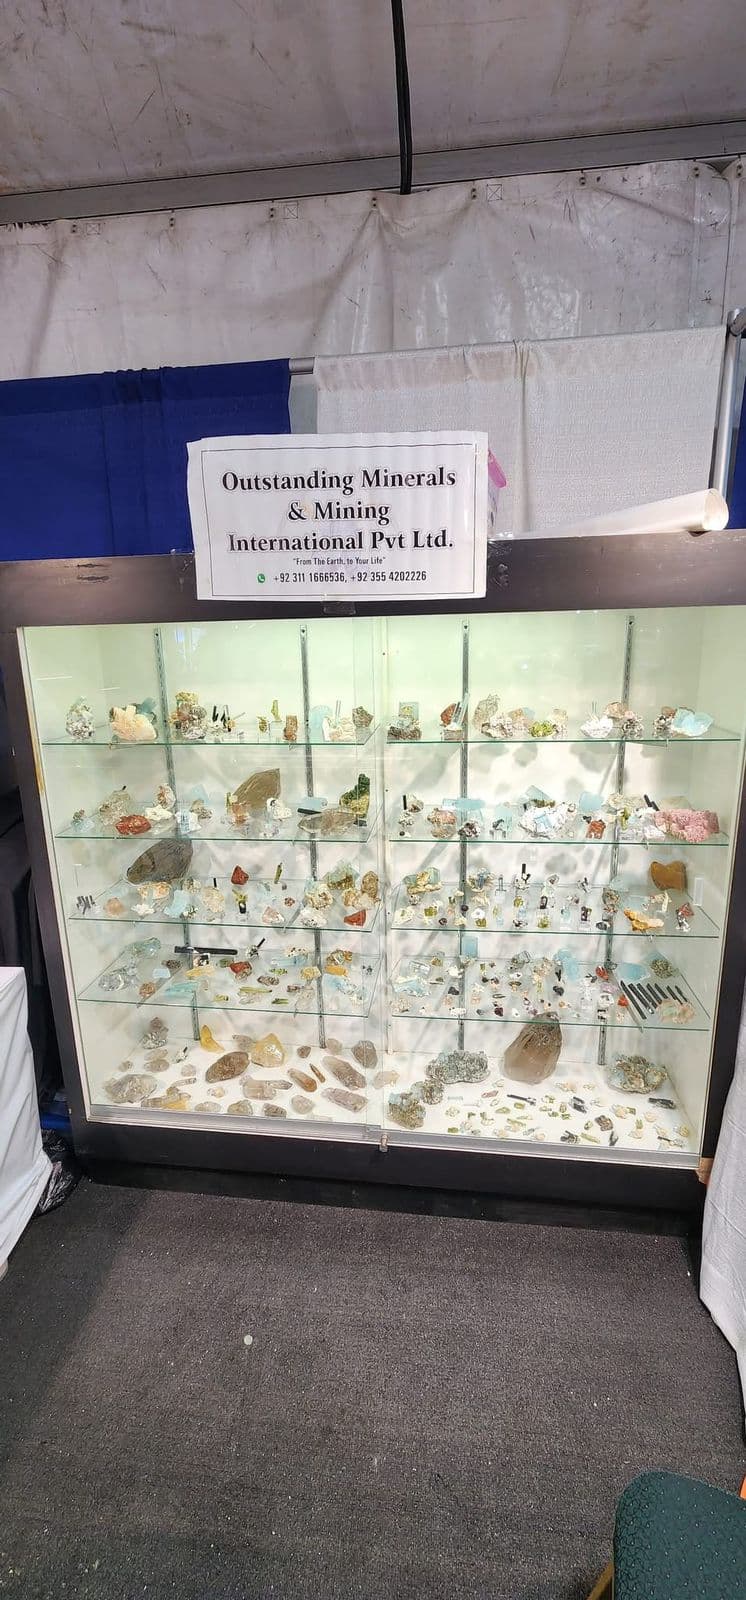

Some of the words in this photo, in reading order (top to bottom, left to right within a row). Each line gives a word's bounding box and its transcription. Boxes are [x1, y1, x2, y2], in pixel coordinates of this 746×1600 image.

[222, 469, 354, 494] Outstanding
[361, 466, 456, 489] Minerals
[288, 502, 307, 521] &
[314, 501, 390, 526] Mining
[228, 532, 363, 552] International
[372, 531, 405, 549] Pvt
[413, 529, 453, 549] Ltd.
[313, 557, 326, 566] The
[346, 557, 354, 566] to
[355, 557, 370, 566] Your
[273, 572, 290, 583] +92
[292, 572, 306, 583] 311
[308, 571, 348, 585] 1666536,
[350, 571, 369, 582] +92
[370, 571, 387, 582] 355
[388, 570, 427, 582] 4202226
